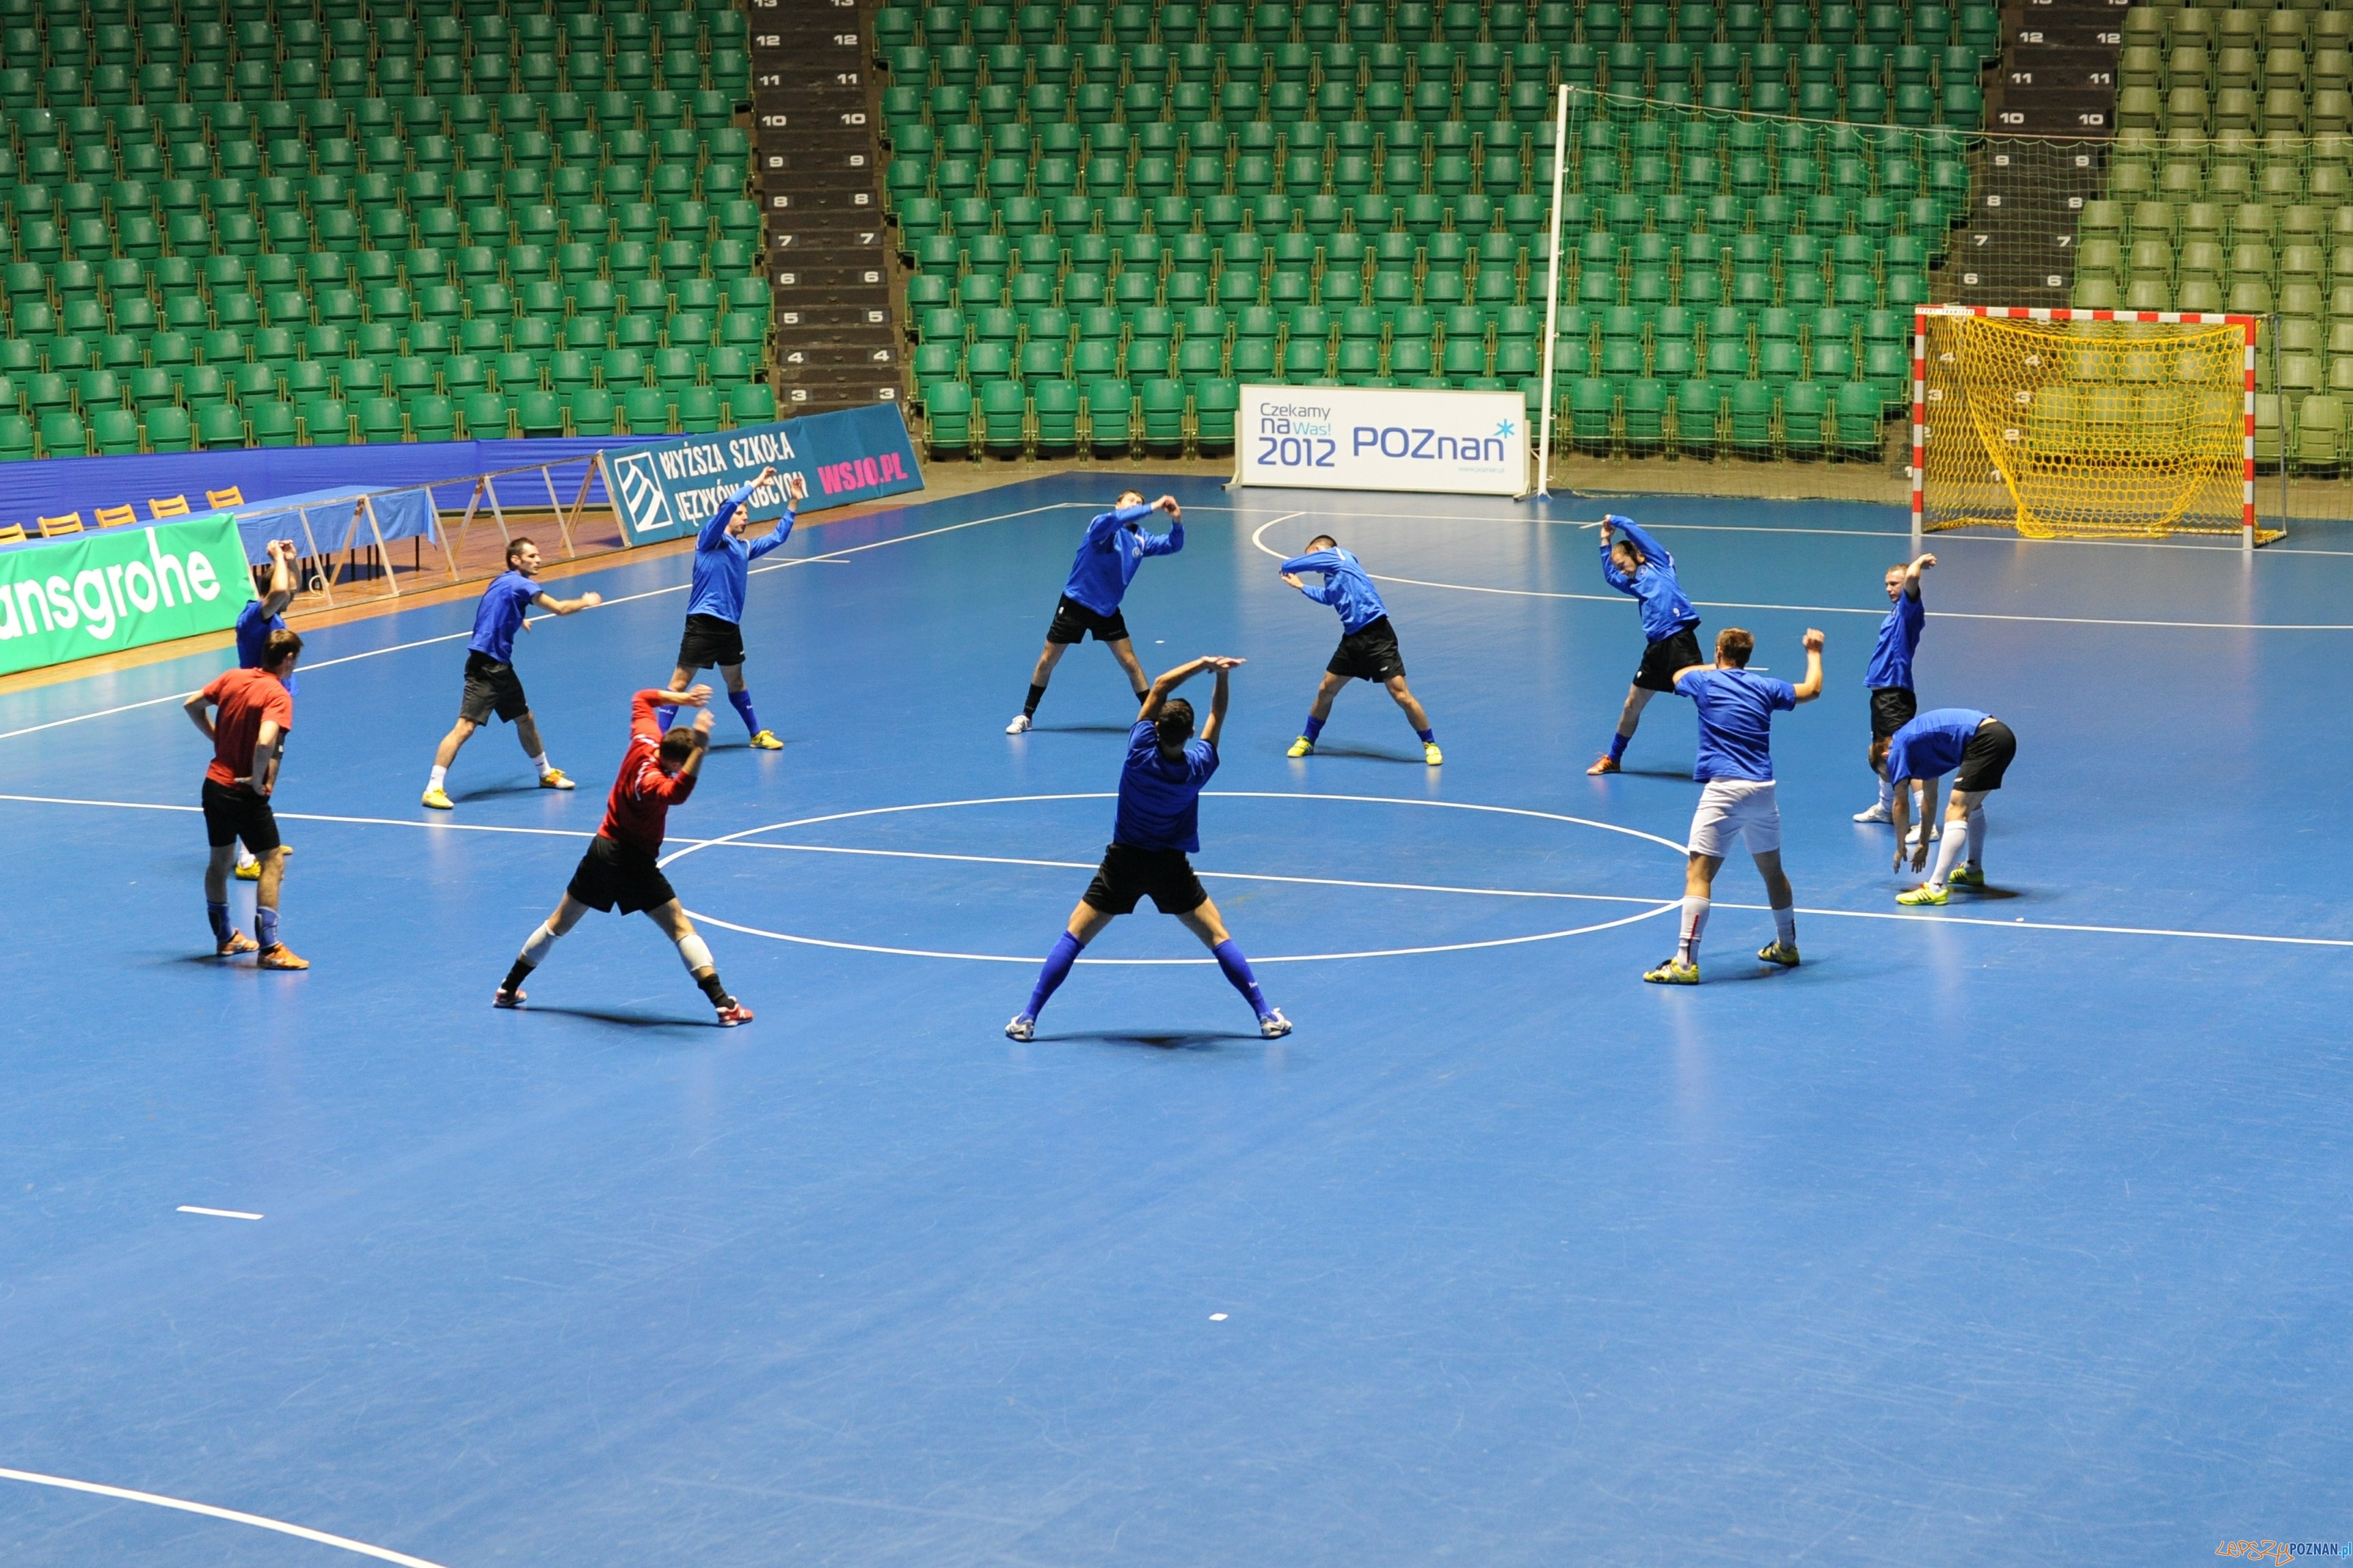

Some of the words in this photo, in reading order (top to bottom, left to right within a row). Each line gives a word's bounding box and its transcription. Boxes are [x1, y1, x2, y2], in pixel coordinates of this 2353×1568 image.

[756, 35, 780, 46] 12
[834, 34, 858, 46] 12
[2019, 31, 2043, 43] 12
[2097, 33, 2121, 44] 12
[759, 75, 780, 86] 11
[837, 74, 858, 84] 11
[2012, 73, 2032, 84] 11
[2090, 73, 2110, 84] 11
[762, 116, 787, 126] 10
[841, 113, 865, 124] 10
[2000, 112, 2024, 124] 10
[2079, 113, 2103, 125] 10
[769, 157, 783, 167] 9
[850, 155, 864, 166] 9
[1995, 155, 2009, 166] 9
[2075, 155, 2089, 167] 9
[774, 196, 788, 207] 8
[855, 193, 869, 205] 8
[1987, 195, 2001, 206] 8
[2069, 197, 2083, 208] 8
[778, 235, 792, 246] 7
[860, 233, 874, 244] 7
[1974, 235, 1989, 246] 7
[2056, 236, 2071, 247] 7
[780, 273, 795, 284] 6
[864, 271, 879, 282] 6
[1964, 273, 1978, 284] 6
[2047, 275, 2062, 286] 6
[783, 312, 798, 324] 5
[868, 310, 883, 323] 5
[788, 352, 804, 364] 4
[873, 350, 889, 361] 4
[1940, 352, 1956, 362] 4
[2025, 355, 2041, 366] 4
[791, 390, 807, 401] 3
[879, 388, 895, 399] 3
[1928, 390, 1943, 401] 3
[2016, 391, 2031, 403] 3
[1260, 402, 1331, 421] Czekamy
[1261, 418, 1291, 434] na
[1293, 422, 1332, 436] Was!
[2005, 429, 2019, 440] 2
[658, 441, 728, 480] WYŻSZA
[729, 431, 795, 469] SZKOŁA
[1257, 437, 1336, 468] 2012
[817, 452, 908, 496] WSJO.PL
[1905, 465, 1913, 478] 1
[1991, 470, 2001, 481] 1
[0, 526, 221, 640] ansgrohe
[1673, 607, 1680, 617] 9
